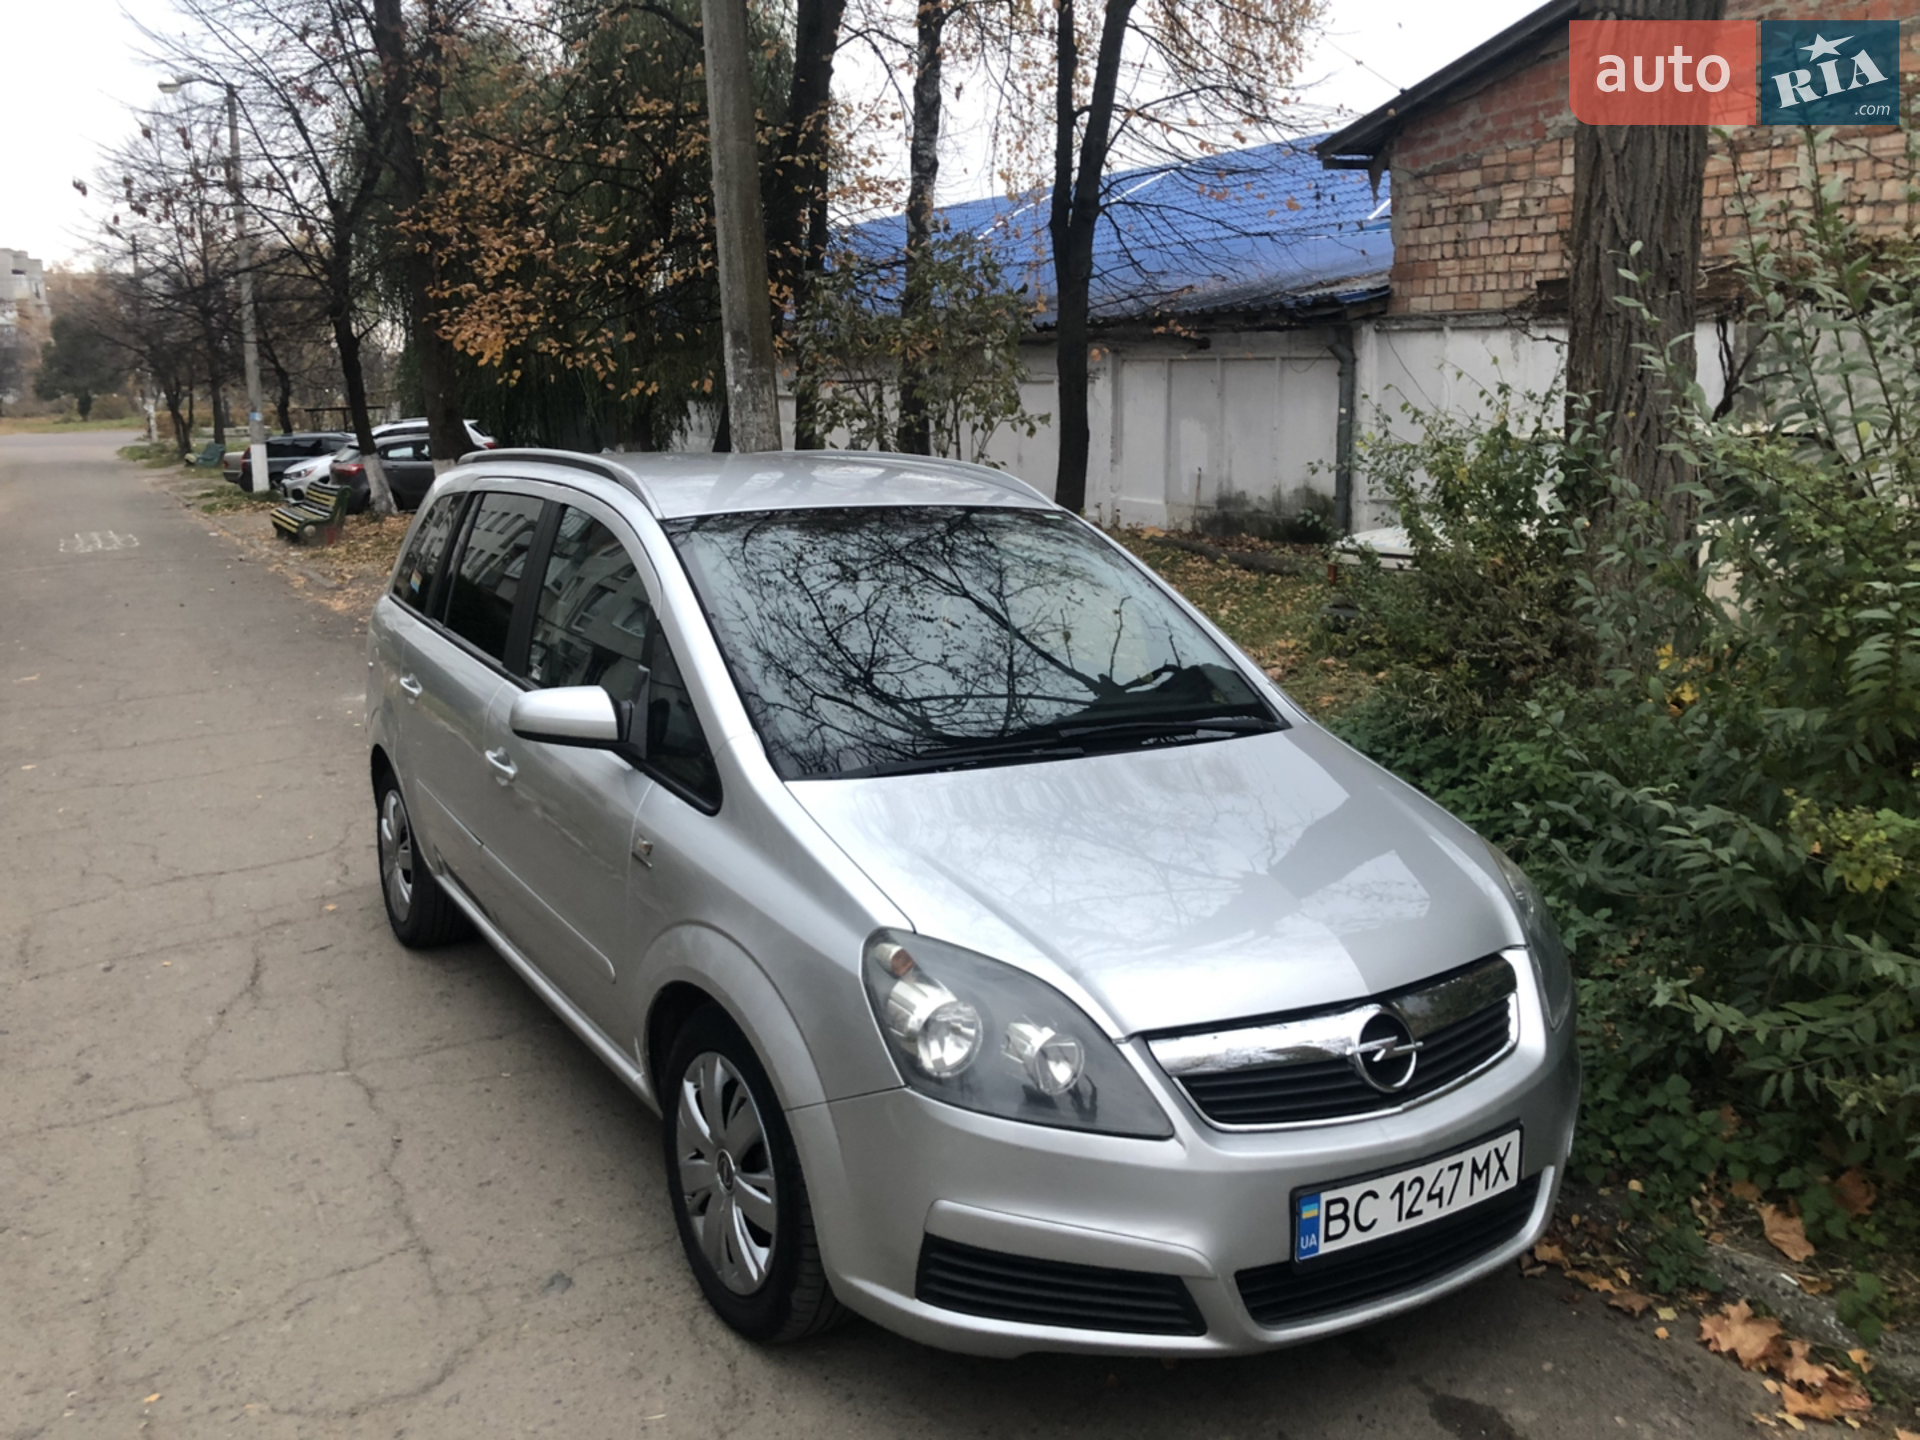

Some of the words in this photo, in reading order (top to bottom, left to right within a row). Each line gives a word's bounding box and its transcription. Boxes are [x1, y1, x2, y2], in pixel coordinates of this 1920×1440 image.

[1324, 1190, 1379, 1243] BC
[1390, 1162, 1464, 1222] 1247
[1469, 1141, 1512, 1196] MX
[1300, 1233, 1318, 1249] UA
